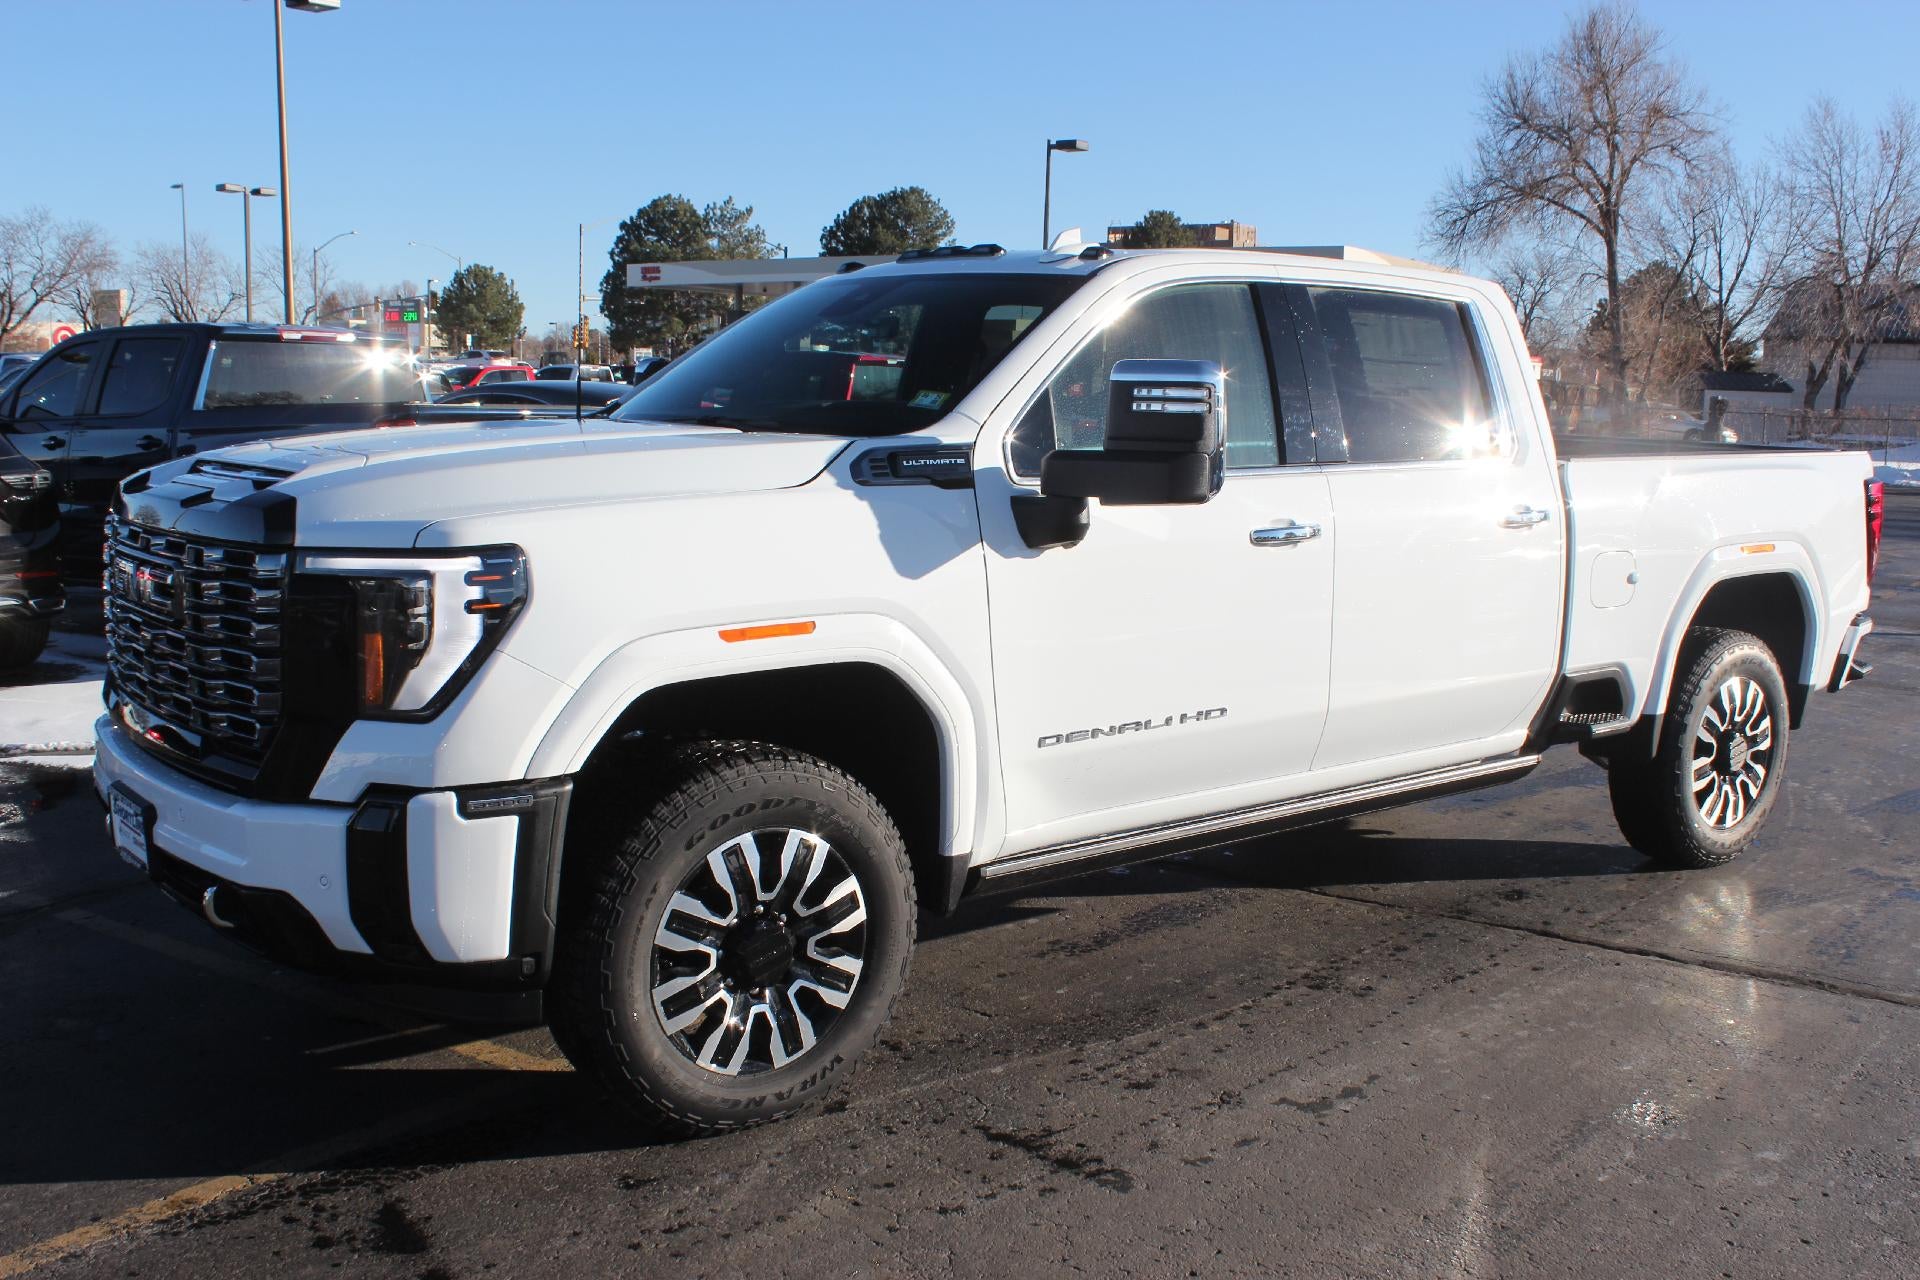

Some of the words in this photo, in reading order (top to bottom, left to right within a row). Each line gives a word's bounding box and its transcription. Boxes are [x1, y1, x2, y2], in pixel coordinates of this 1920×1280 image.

[903, 458, 966, 466] ULTIMATE
[1037, 715, 1173, 748] DENALI
[1180, 707, 1228, 724] HD
